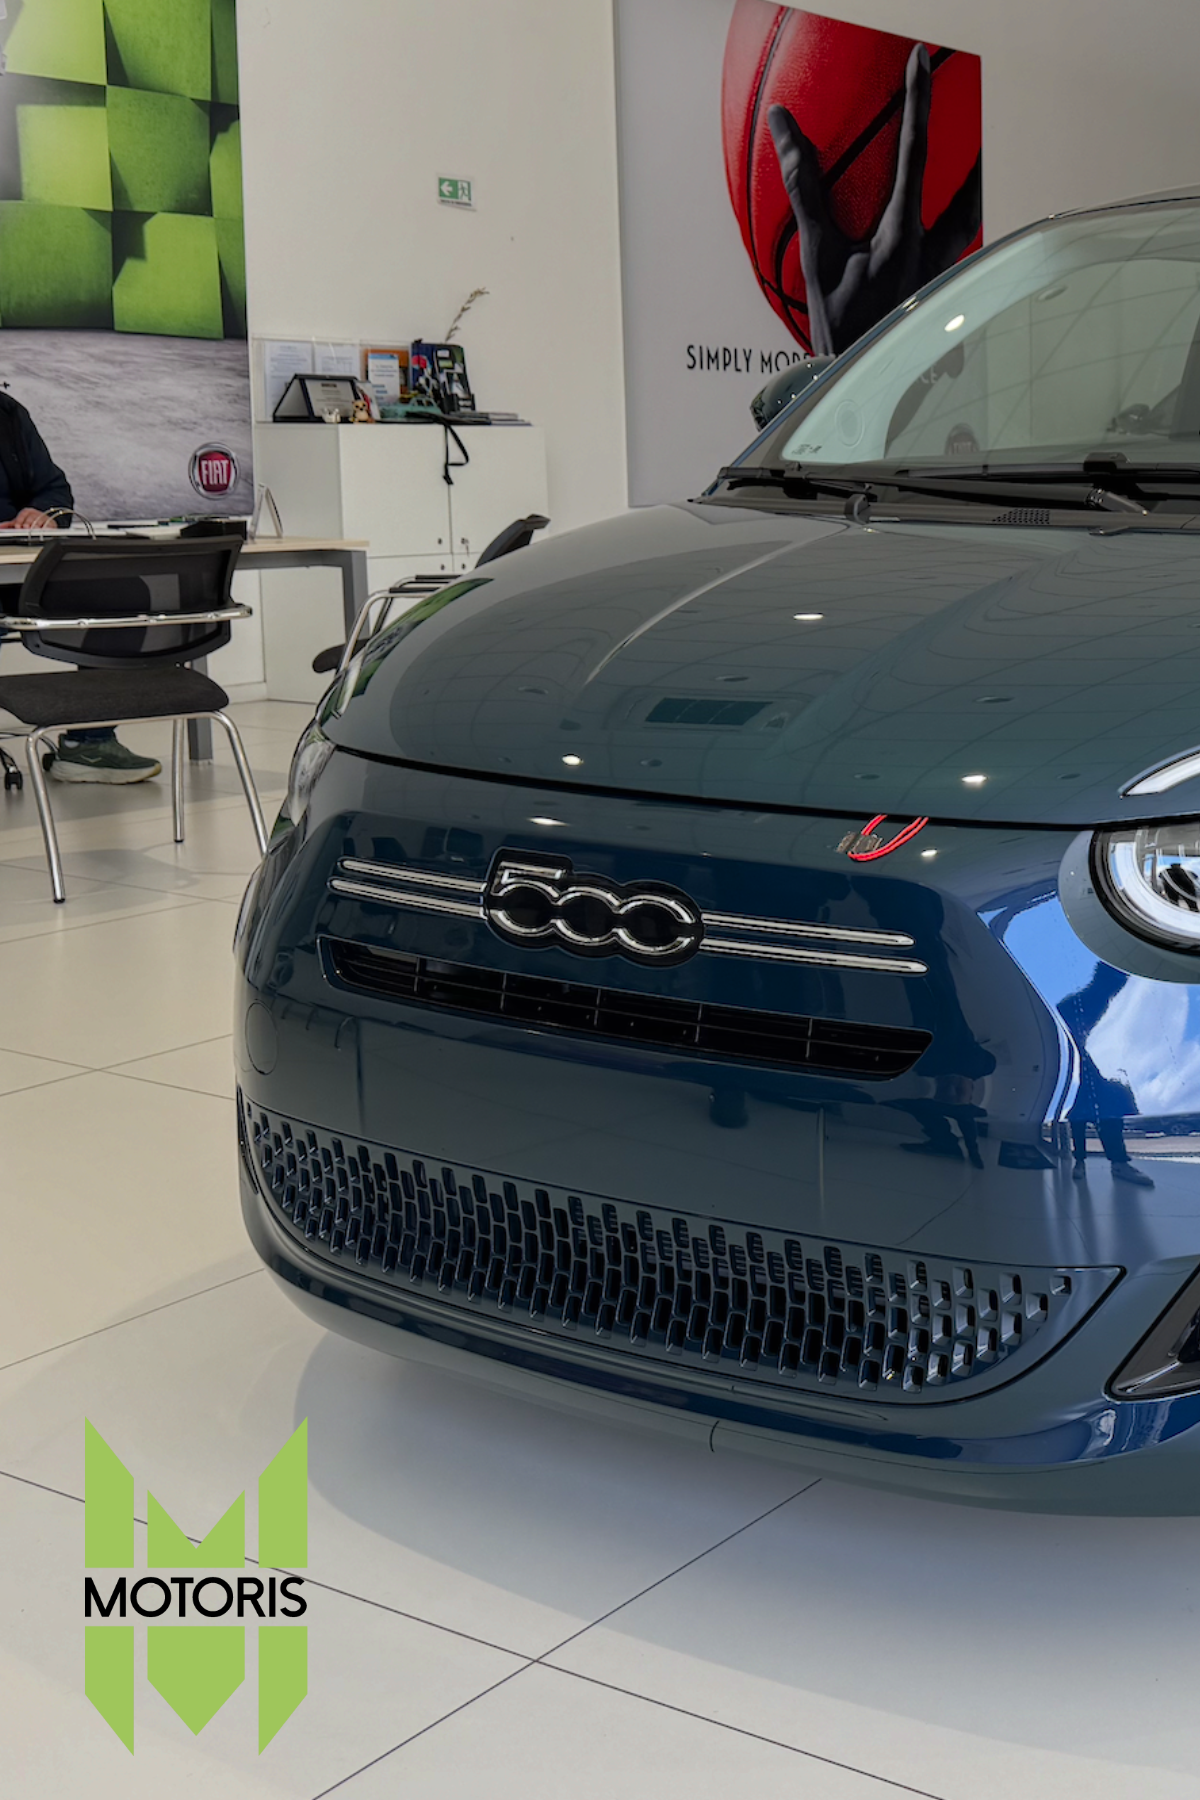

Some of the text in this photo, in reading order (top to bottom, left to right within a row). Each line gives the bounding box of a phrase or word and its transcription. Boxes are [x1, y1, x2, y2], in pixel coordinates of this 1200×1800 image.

[686, 344, 811, 374] SIMPLY MO
[200, 459, 229, 486] FIAT
[490, 861, 696, 955] 500
